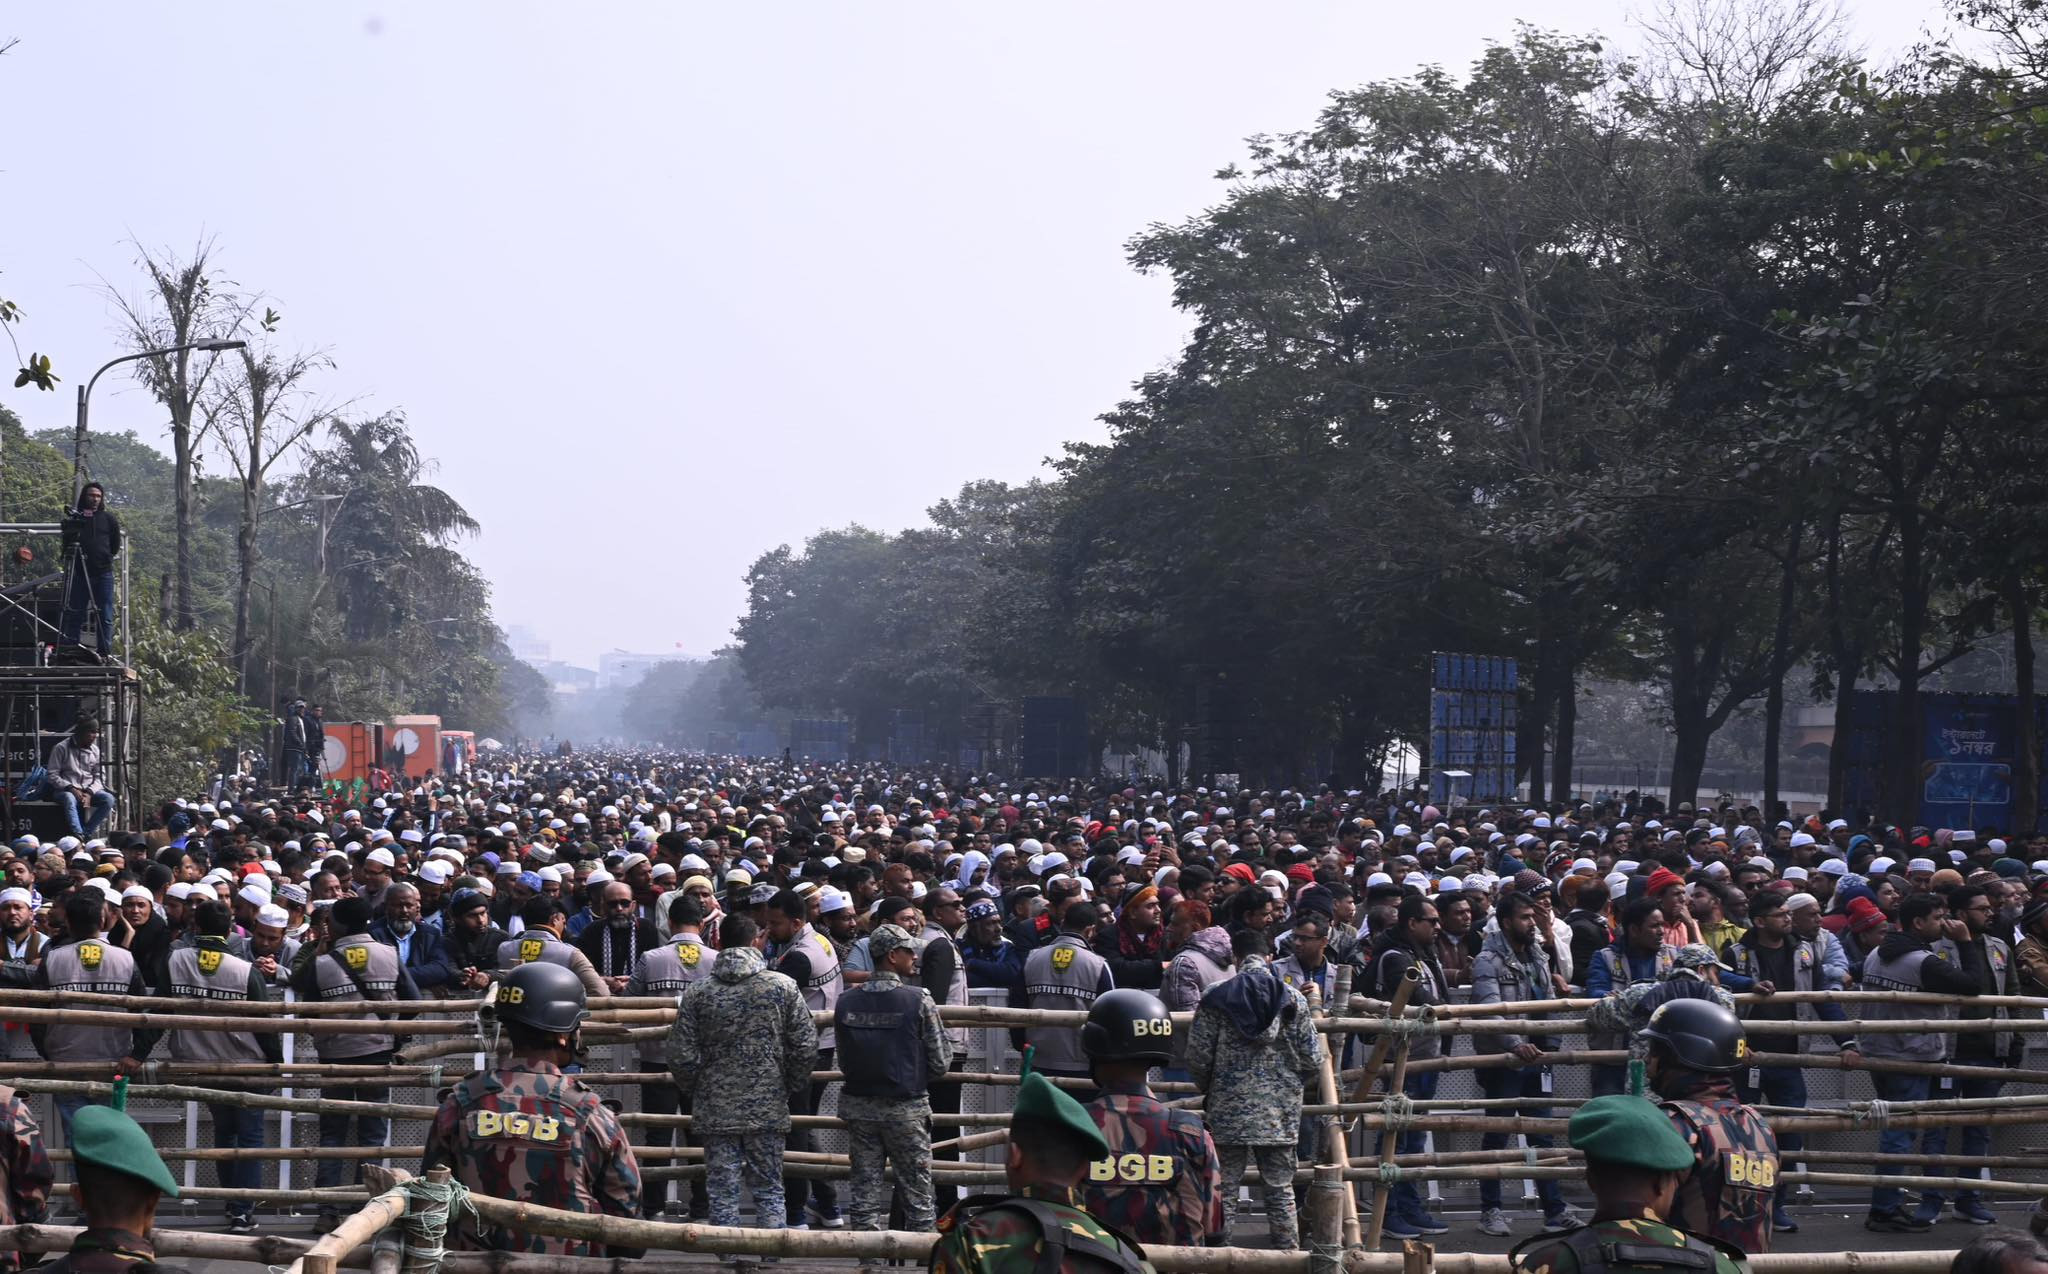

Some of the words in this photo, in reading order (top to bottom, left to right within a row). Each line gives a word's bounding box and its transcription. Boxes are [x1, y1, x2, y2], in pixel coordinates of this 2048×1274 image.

[80, 945, 101, 959] DB
[345, 948, 368, 964] DB
[521, 940, 542, 956] DB
[678, 944, 699, 959] DB
[1053, 948, 1073, 962] DB
[199, 950, 221, 965] DB
[843, 1012, 903, 1026] POLICE
[1133, 1018, 1172, 1037] BGB
[477, 1110, 560, 1141] BGB
[1090, 1153, 1174, 1181] BGB
[1730, 1153, 1774, 1188] BGB
